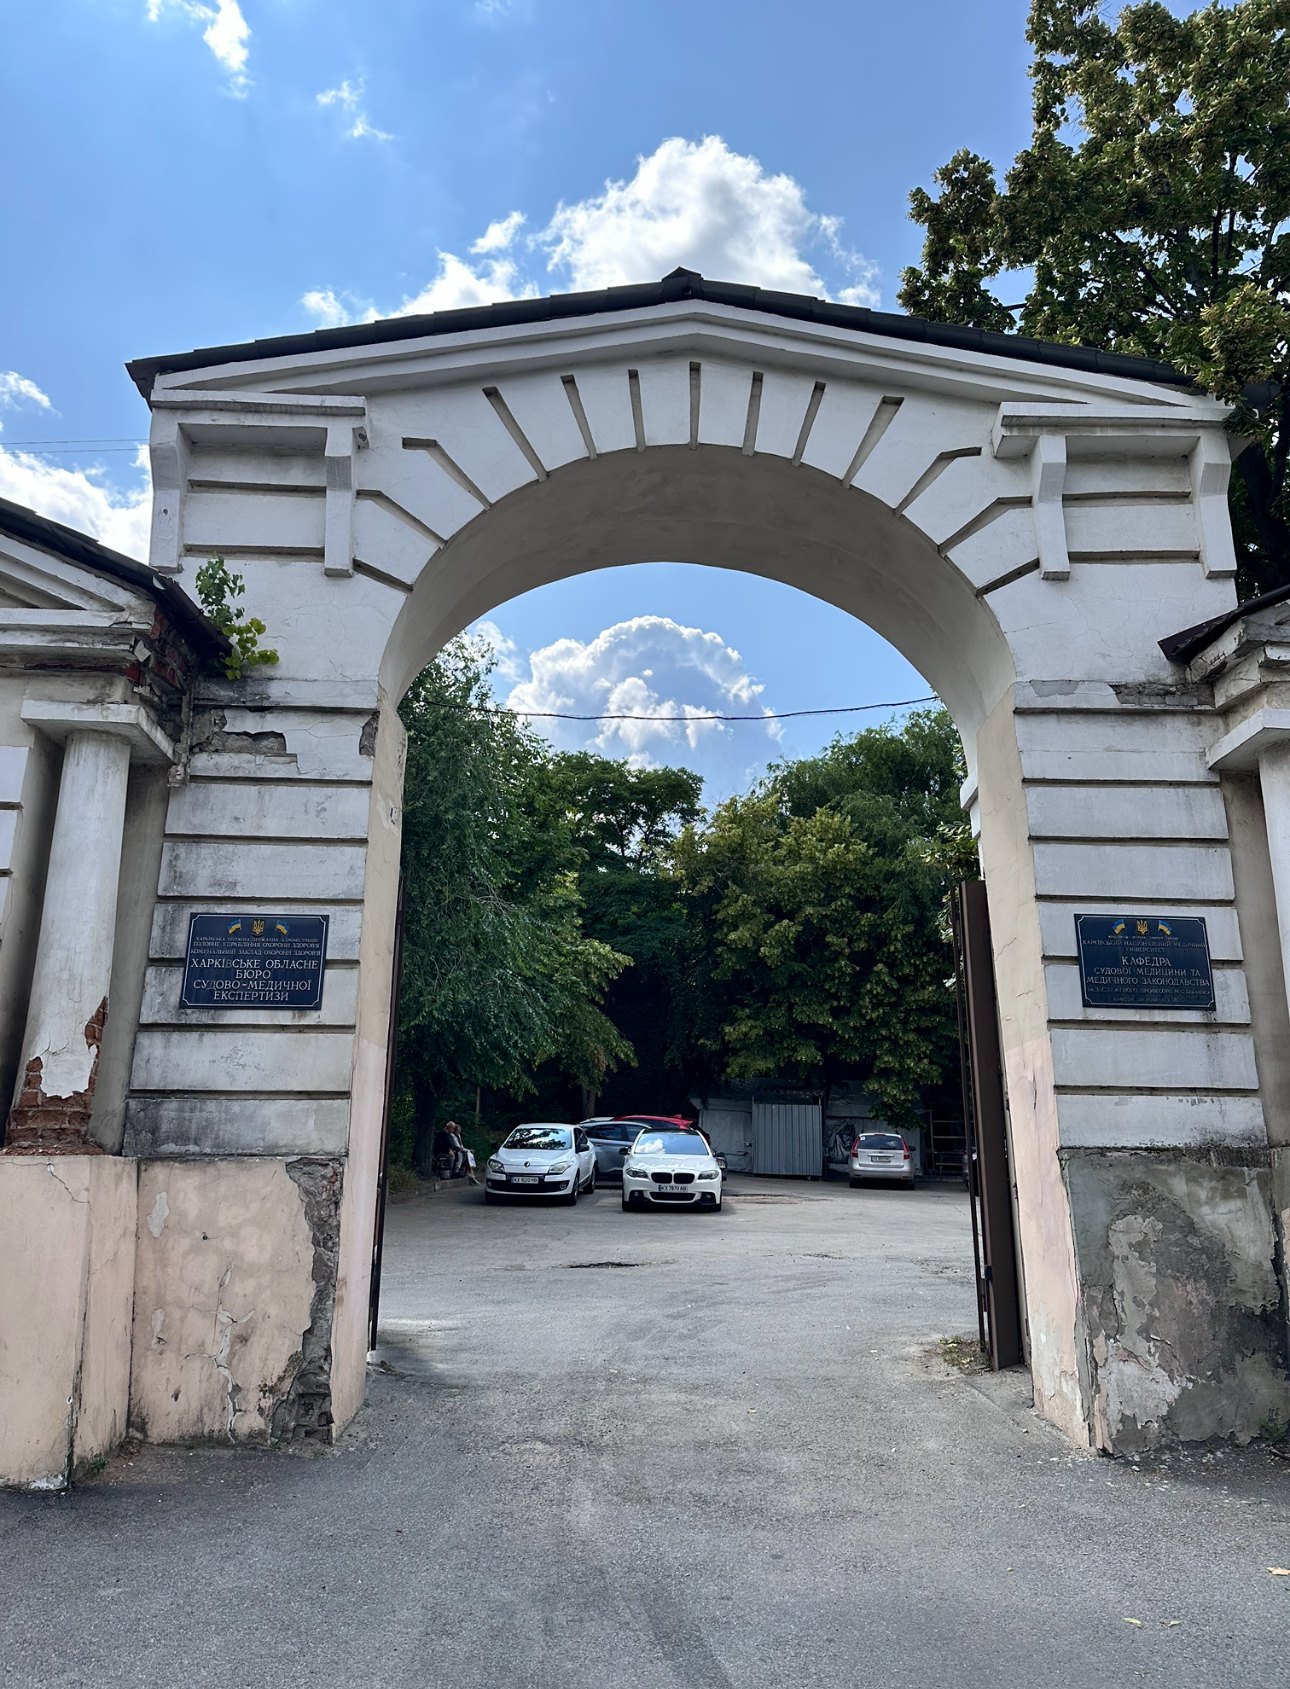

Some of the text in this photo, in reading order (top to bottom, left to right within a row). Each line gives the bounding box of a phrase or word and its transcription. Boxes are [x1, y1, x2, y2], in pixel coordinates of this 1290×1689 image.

[190, 958, 319, 970] ХАРКІВСЬКЕ ОБЛАСНЕ
[1121, 956, 1172, 967] КАФЕДРА
[235, 969, 272, 979] БЮРО
[1136, 968, 1187, 977] МЕДИЦИНИ
[1190, 968, 1201, 977] ТА
[1086, 976, 1210, 987] МЕДИЧНОГО ЗАКОНОДАВСТВА
[213, 991, 289, 1001] ЕКСПЕРТИЗИ
